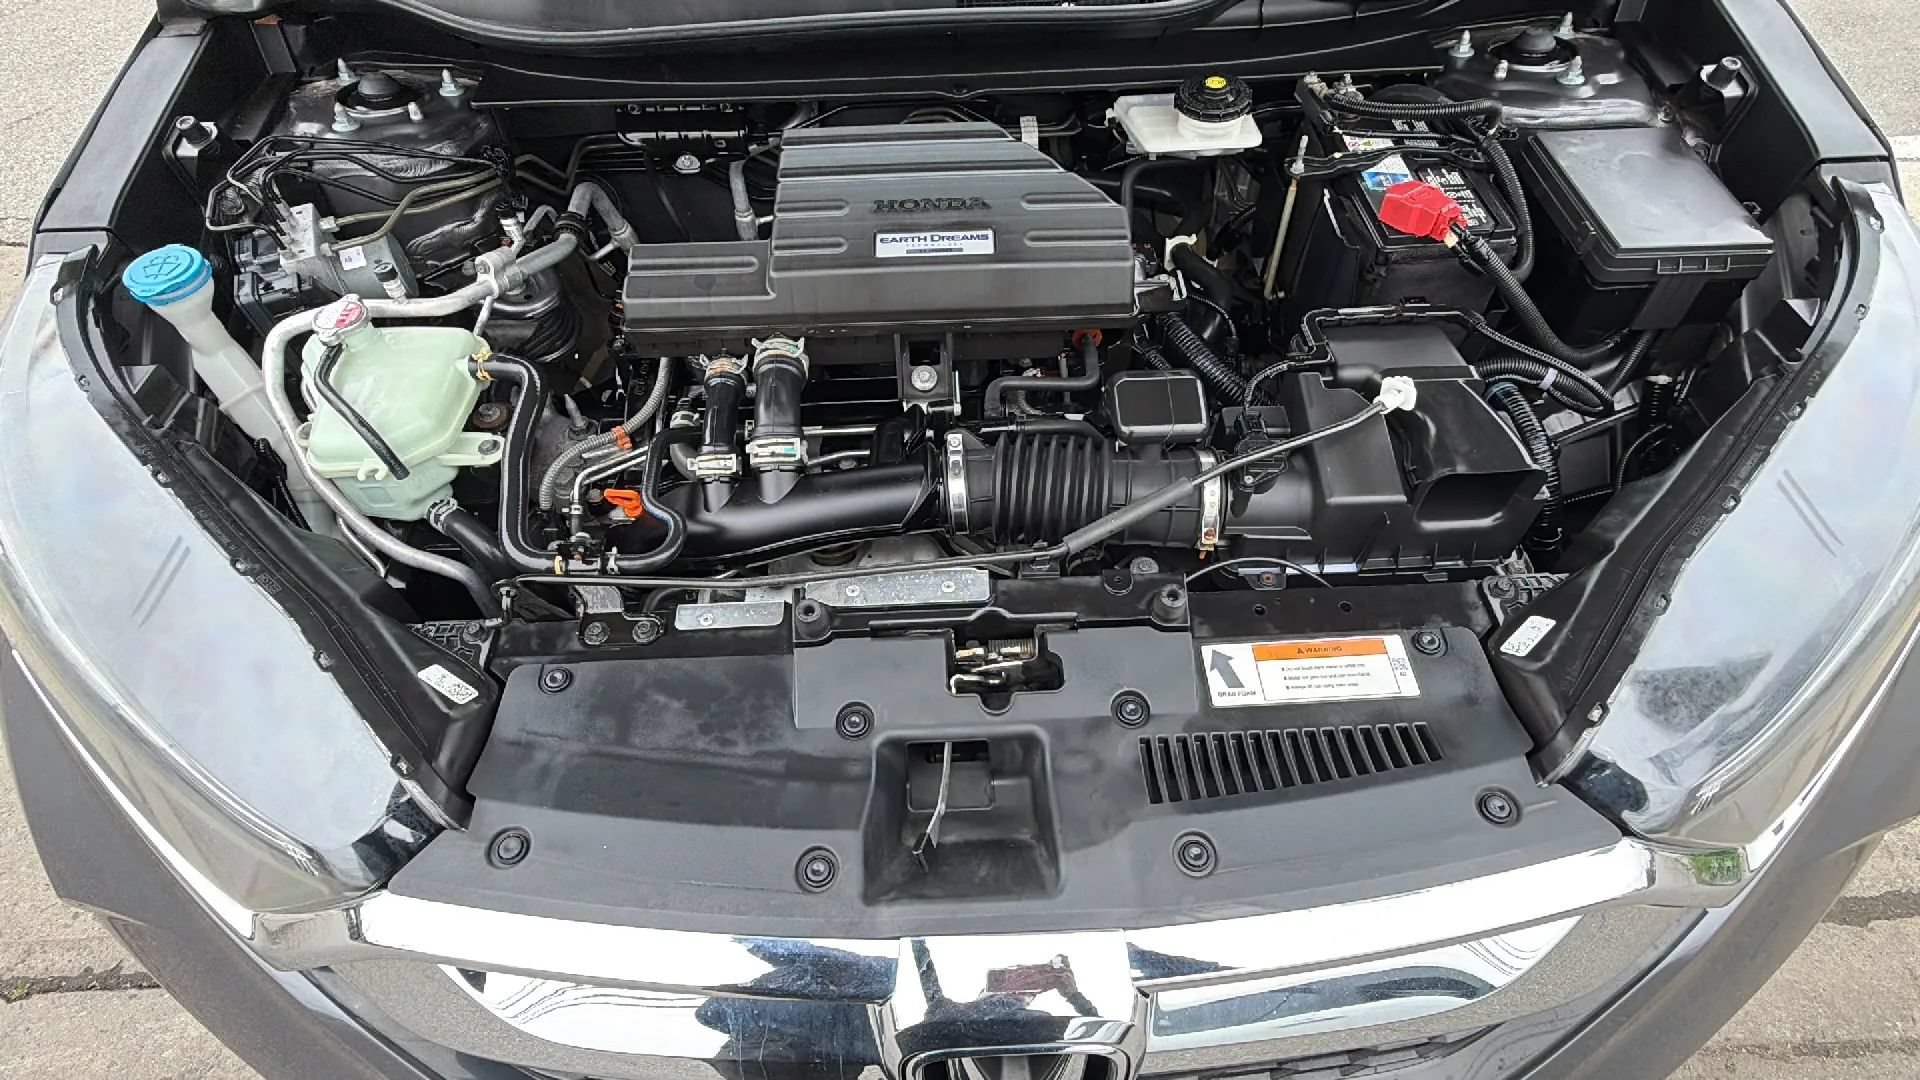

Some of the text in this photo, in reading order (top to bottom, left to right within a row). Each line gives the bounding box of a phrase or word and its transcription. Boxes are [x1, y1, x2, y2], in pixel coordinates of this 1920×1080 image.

[873, 197, 992, 214] HONDA
[879, 234, 989, 244] EARTH DREAMS
